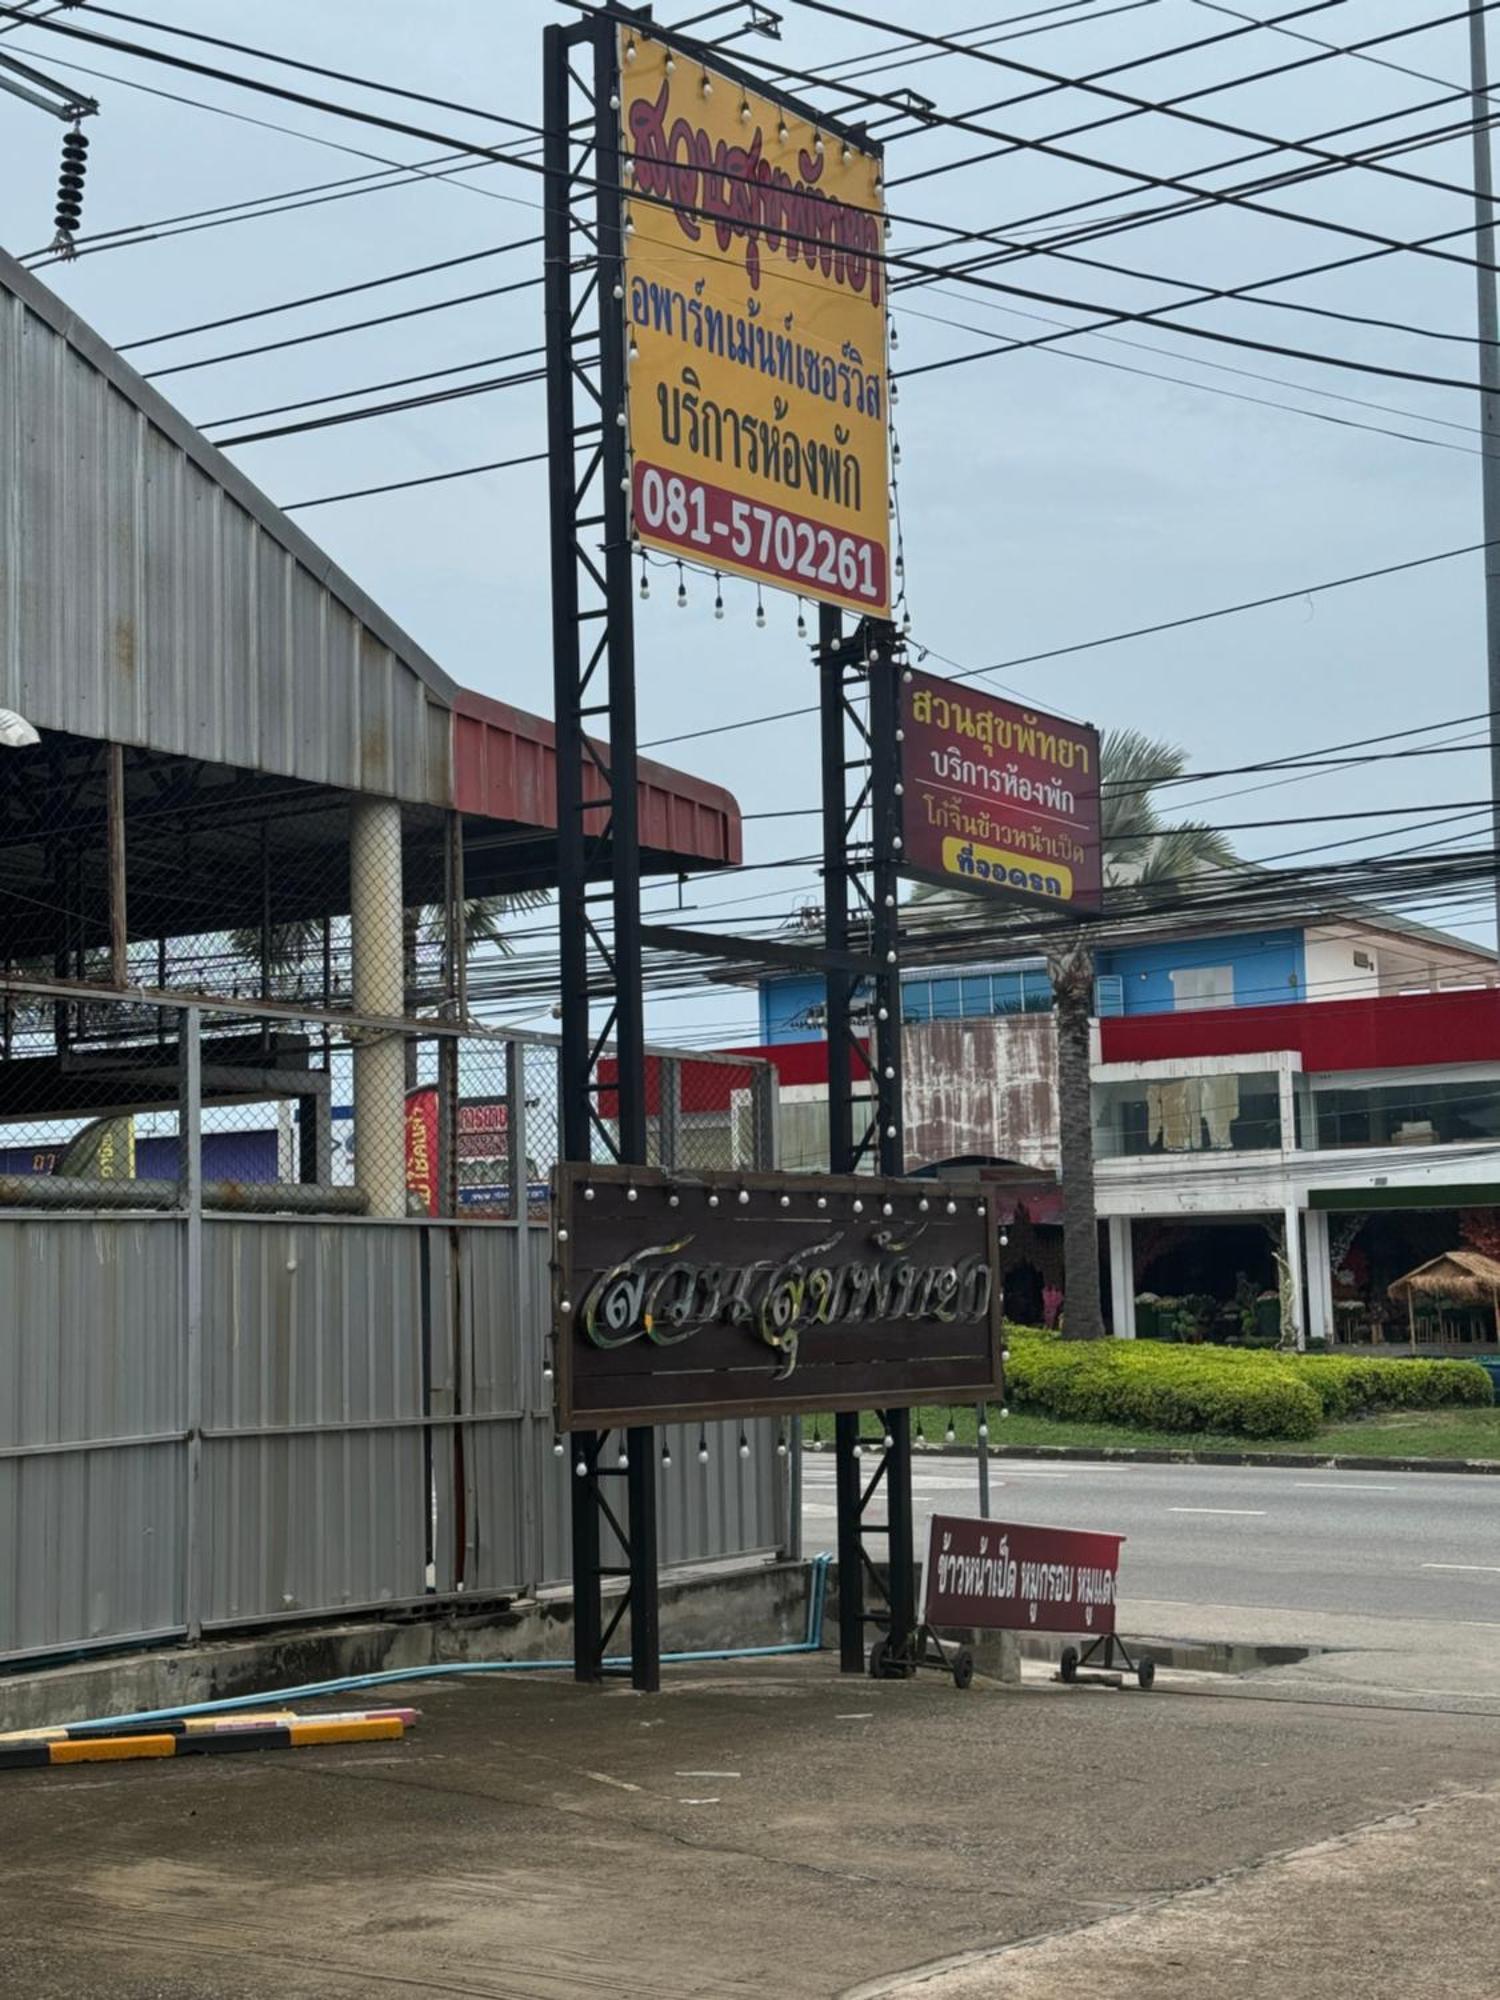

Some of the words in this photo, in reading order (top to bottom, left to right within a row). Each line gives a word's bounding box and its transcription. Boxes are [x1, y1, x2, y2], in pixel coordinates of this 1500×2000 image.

[628, 79, 880, 308] สวนสุขพัทยา
[631, 275, 881, 420] อพาร์ทเม้นท์เซอร์วิส
[657, 366, 861, 511] บริการห้องพัก
[641, 467, 878, 598] 081-5702261
[912, 690, 1088, 773] สวนสุขพัทยา
[930, 746, 1075, 814] บริการห้องพัก
[956, 843, 1062, 896] ที่จอดรถ
[582, 1222, 992, 1381] สวนสุขพัทยา
[937, 1532, 1018, 1599] ข้าวหน้าเป็ด
[1020, 1561, 1074, 1623] หมูกรอบ
